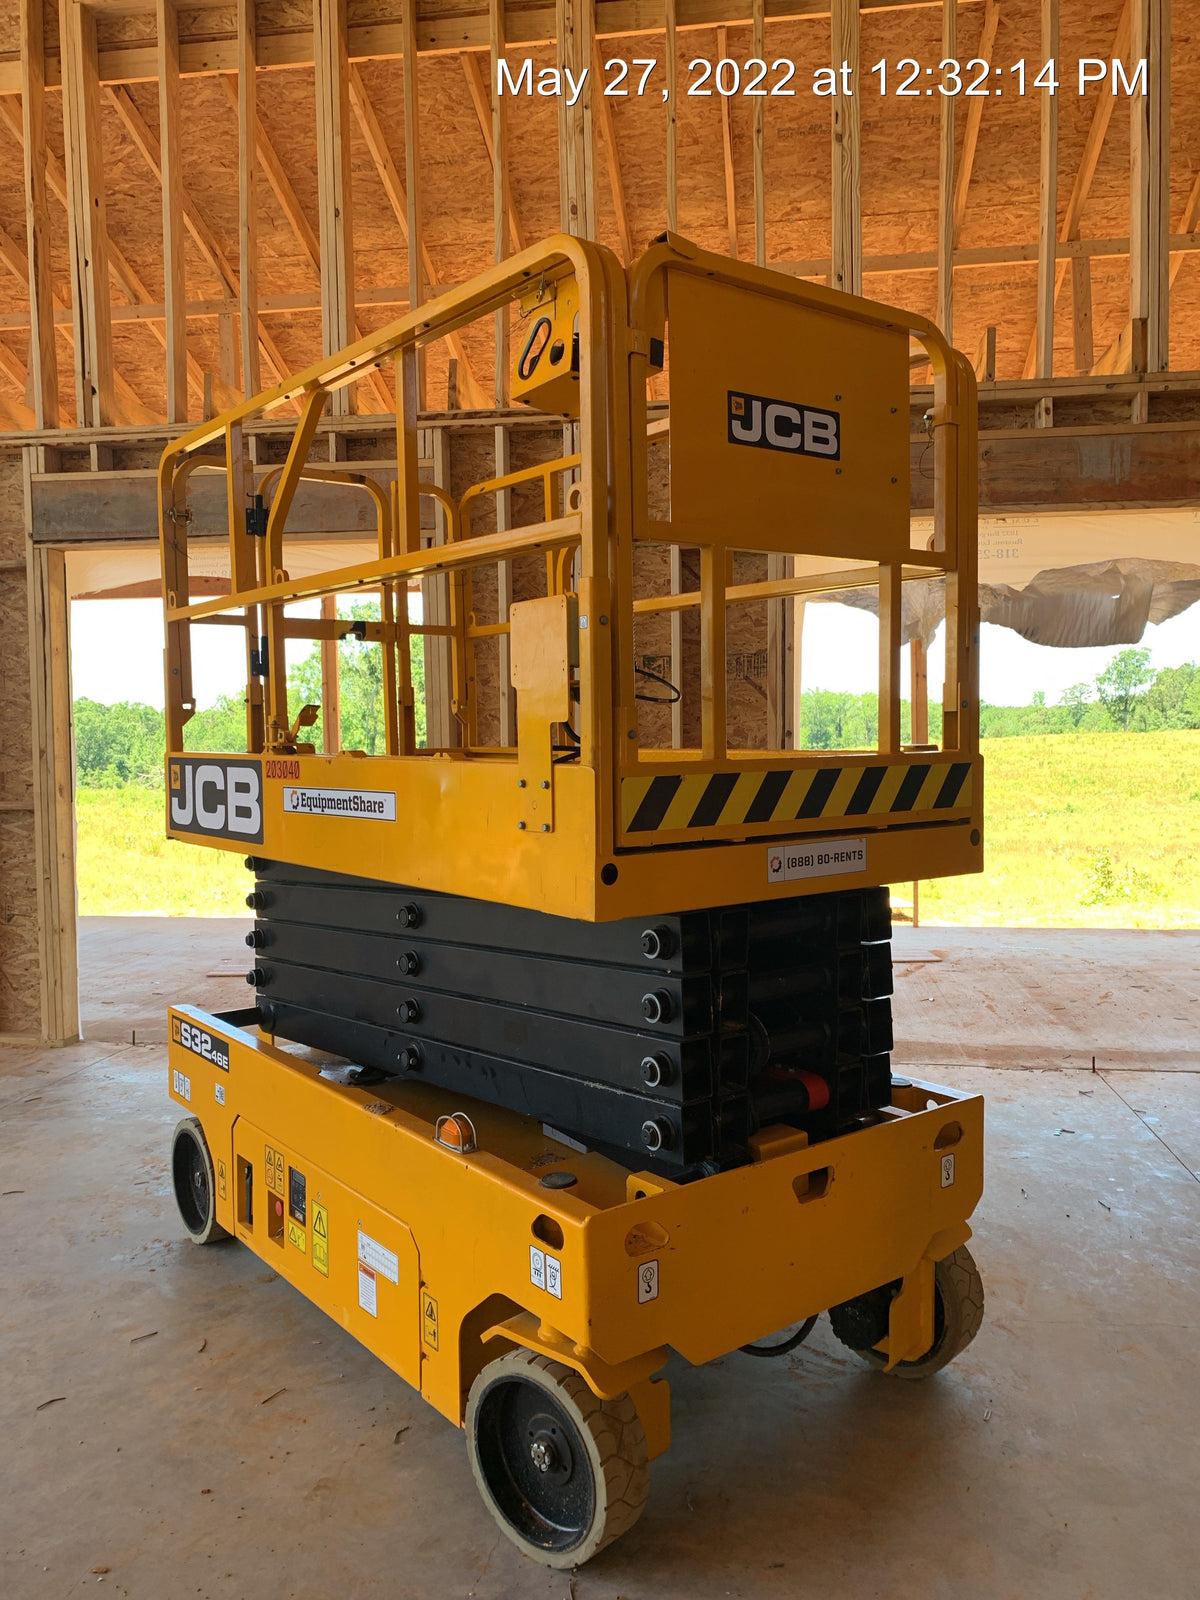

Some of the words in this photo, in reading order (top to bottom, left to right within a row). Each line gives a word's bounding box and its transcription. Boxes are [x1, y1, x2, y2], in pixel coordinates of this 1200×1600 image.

[731, 400, 838, 455] JCB
[265, 760, 300, 779] 203040
[171, 764, 261, 835] JCB
[300, 792, 385, 814] EquipmentShare
[787, 854, 814, 869] (888)
[817, 850, 863, 865] 80-RENTS
[181, 1022, 212, 1060] S32
